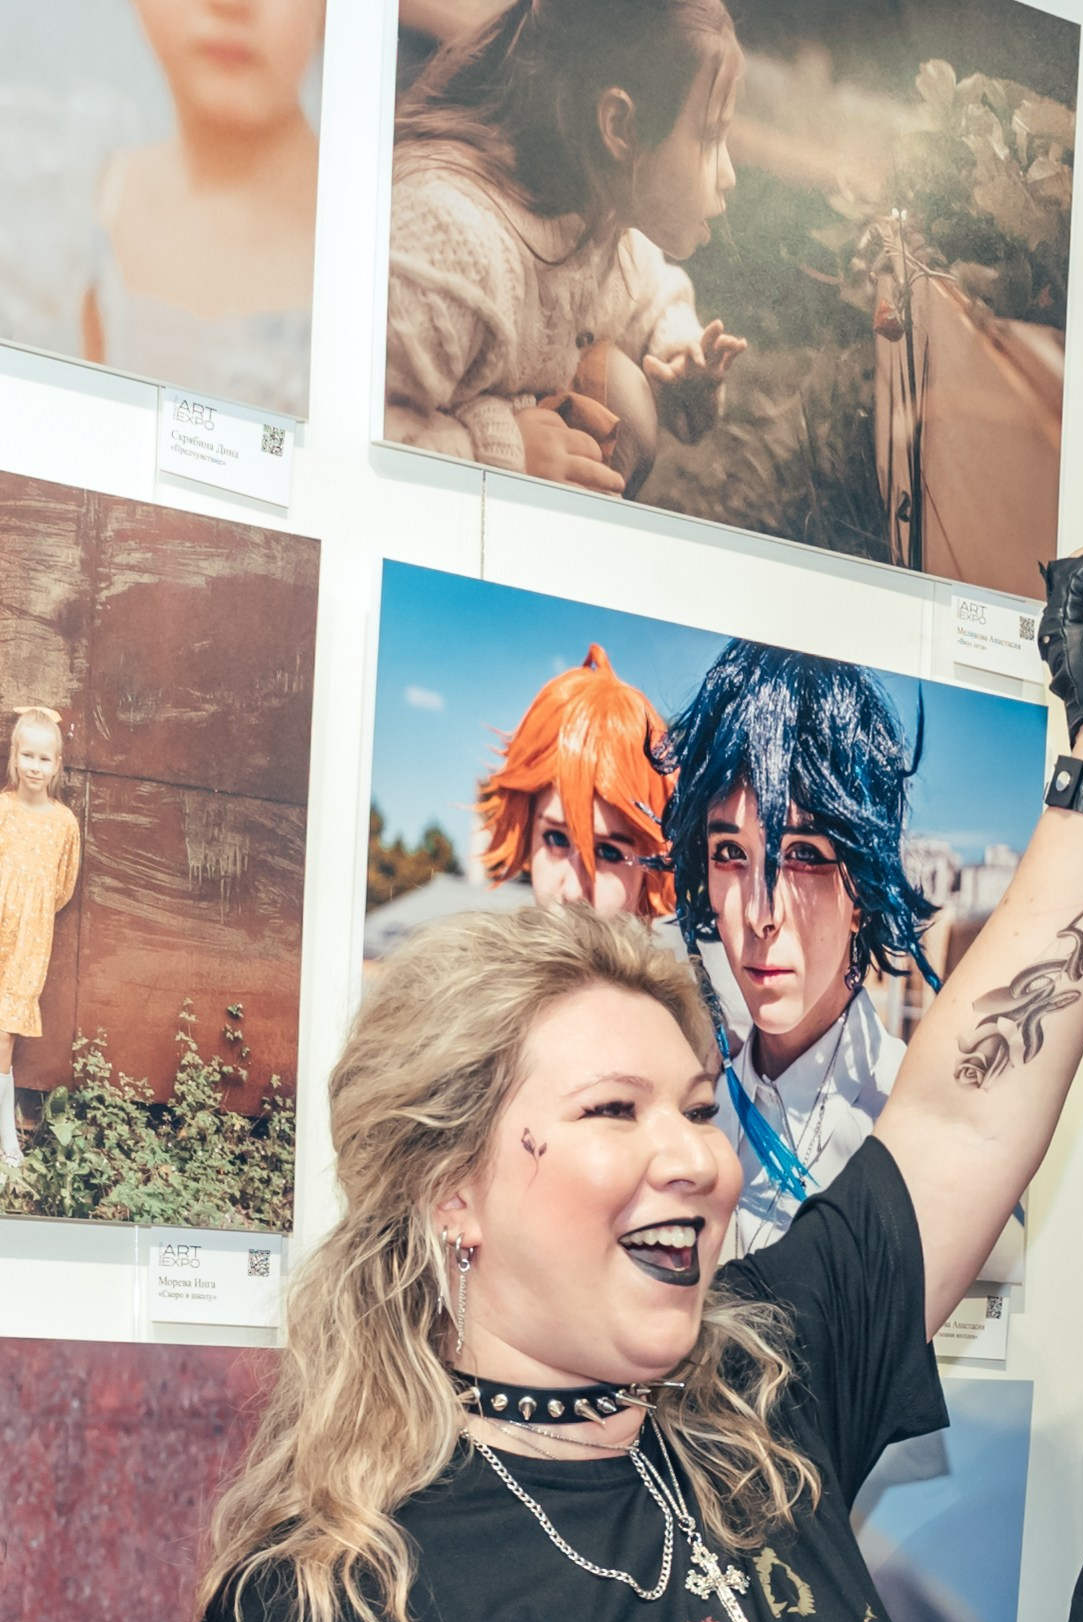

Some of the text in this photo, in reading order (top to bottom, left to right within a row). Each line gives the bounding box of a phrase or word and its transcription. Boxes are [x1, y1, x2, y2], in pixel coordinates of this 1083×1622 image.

[179, 399, 217, 421] ART
[176, 410, 215, 431] EXPO
[960, 601, 987, 617] ART
[959, 610, 987, 625] EXPO
[164, 1244, 202, 1259] ART
[162, 1257, 200, 1269] EXPO
